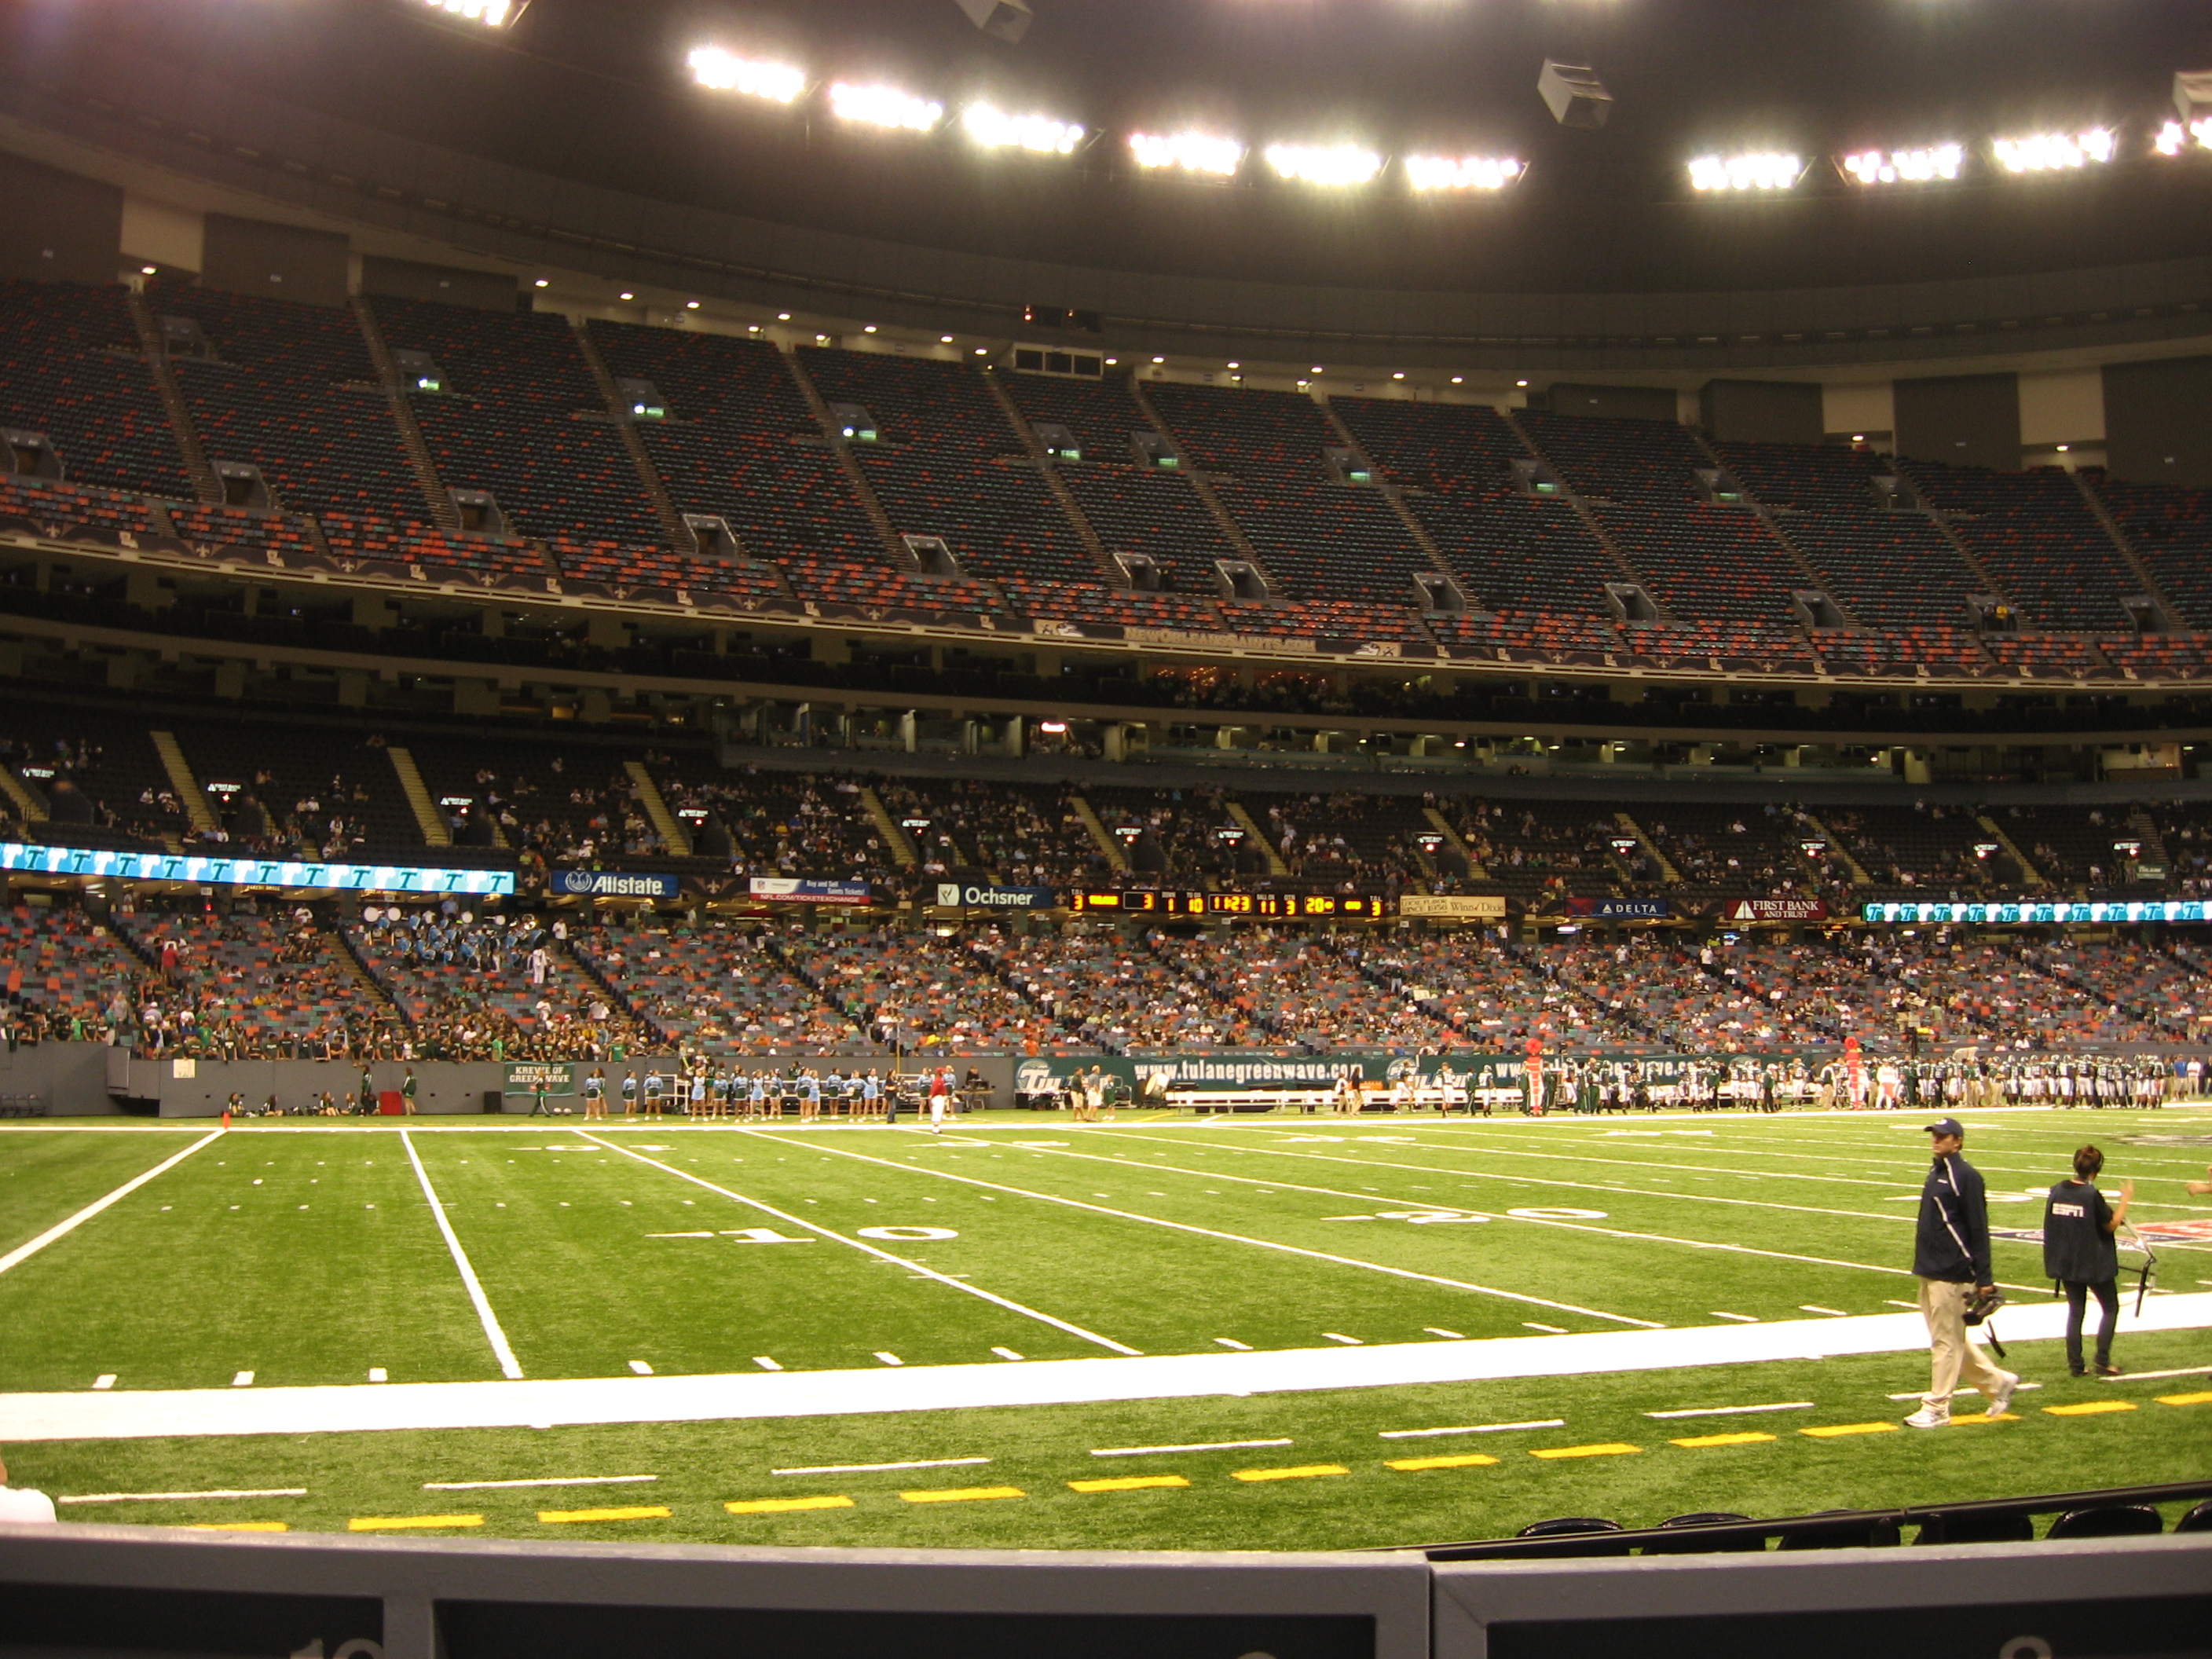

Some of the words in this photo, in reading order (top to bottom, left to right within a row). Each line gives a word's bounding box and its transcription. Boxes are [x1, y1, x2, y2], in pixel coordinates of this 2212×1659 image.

[591, 874, 662, 895] Allstate
[965, 887, 1034, 906] Ochsner
[1074, 895, 1083, 910] 3
[1143, 893, 1153, 910] 3
[1188, 898, 1203, 914] 10
[1286, 899, 1295, 915] 3
[1372, 900, 1381, 917] 3
[1616, 904, 1657, 913] DELTA
[1752, 900, 1785, 910] FIRST
[1786, 900, 1819, 910] BANK
[552, 1066, 564, 1075] OF
[544, 1075, 570, 1083] WAVE
[2052, 1202, 2084, 1218] ESPN
